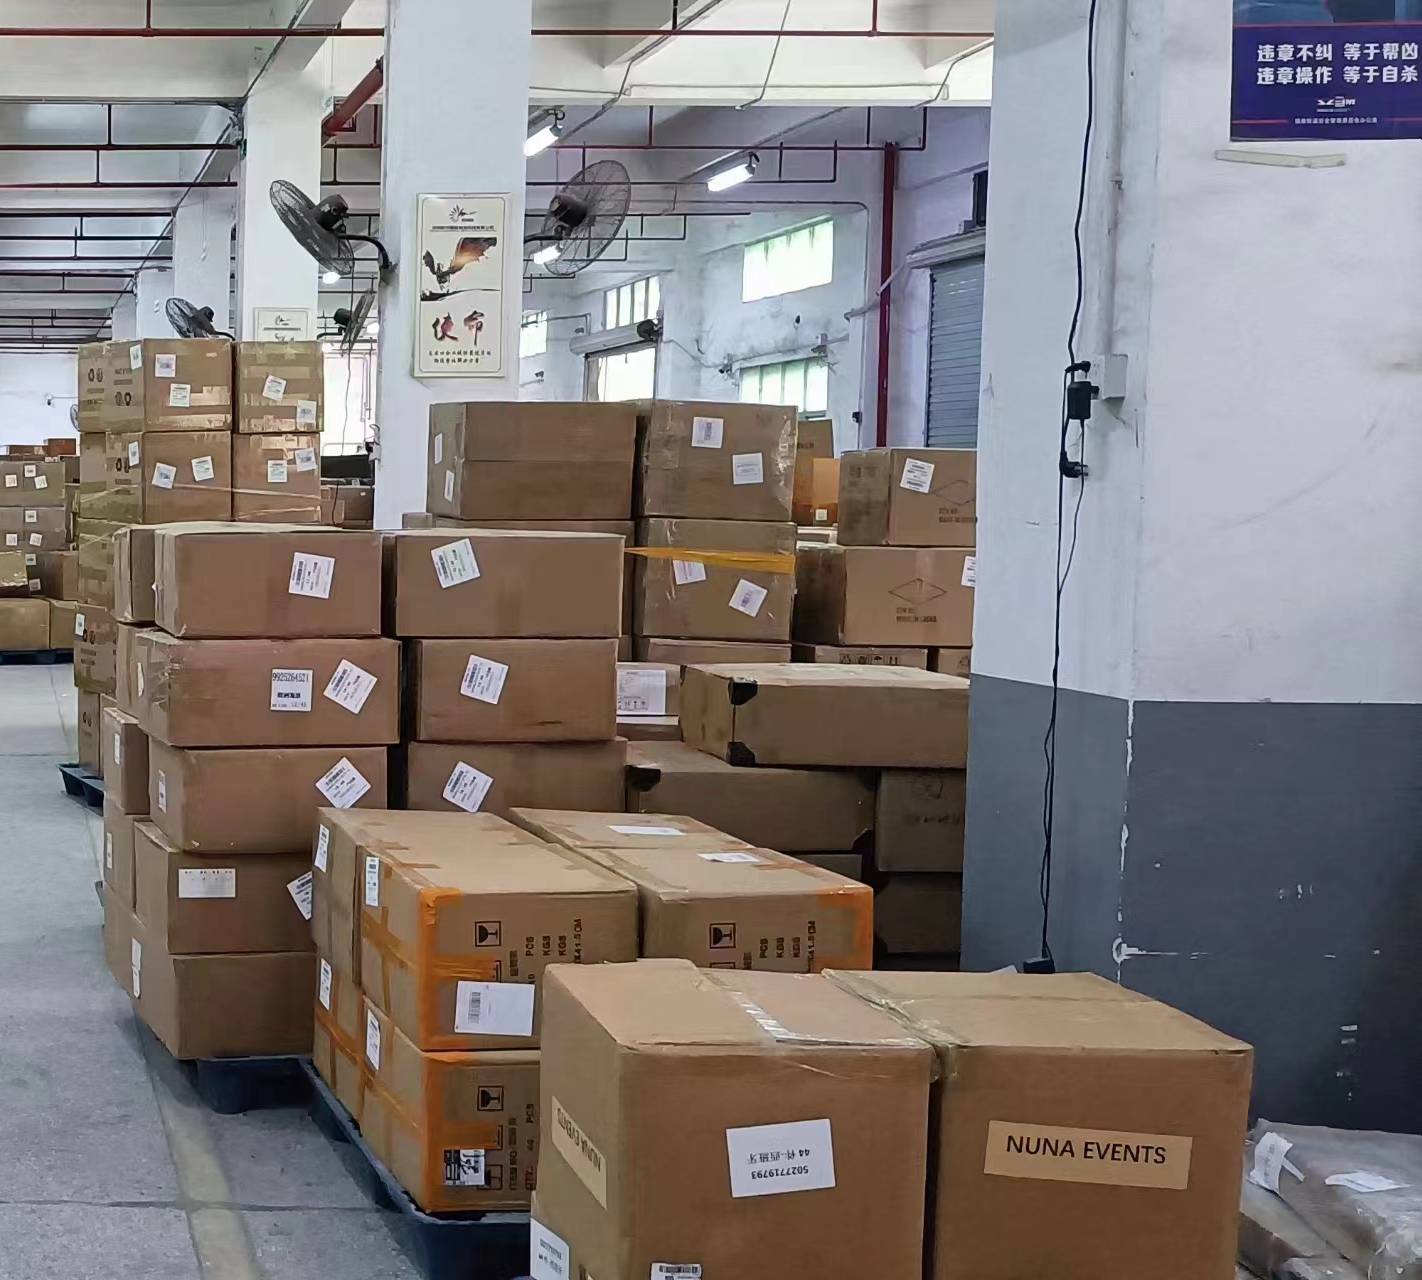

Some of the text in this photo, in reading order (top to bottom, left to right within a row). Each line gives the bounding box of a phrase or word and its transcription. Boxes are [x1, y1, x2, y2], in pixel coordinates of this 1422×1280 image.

[1256, 42, 1419, 62] 违章不纠 等于帮凶
[1256, 65, 1419, 85] 违章操作 等于自杀
[432, 310, 486, 346] 使命
[525, 936, 535, 957] PCS
[543, 935, 552, 957] KGS
[558, 935, 567, 957] KGS
[798, 1148, 811, 1158] 44
[1006, 1134, 1167, 1165] NUNA EVENTS
[751, 1165, 810, 1180] 5027719793
